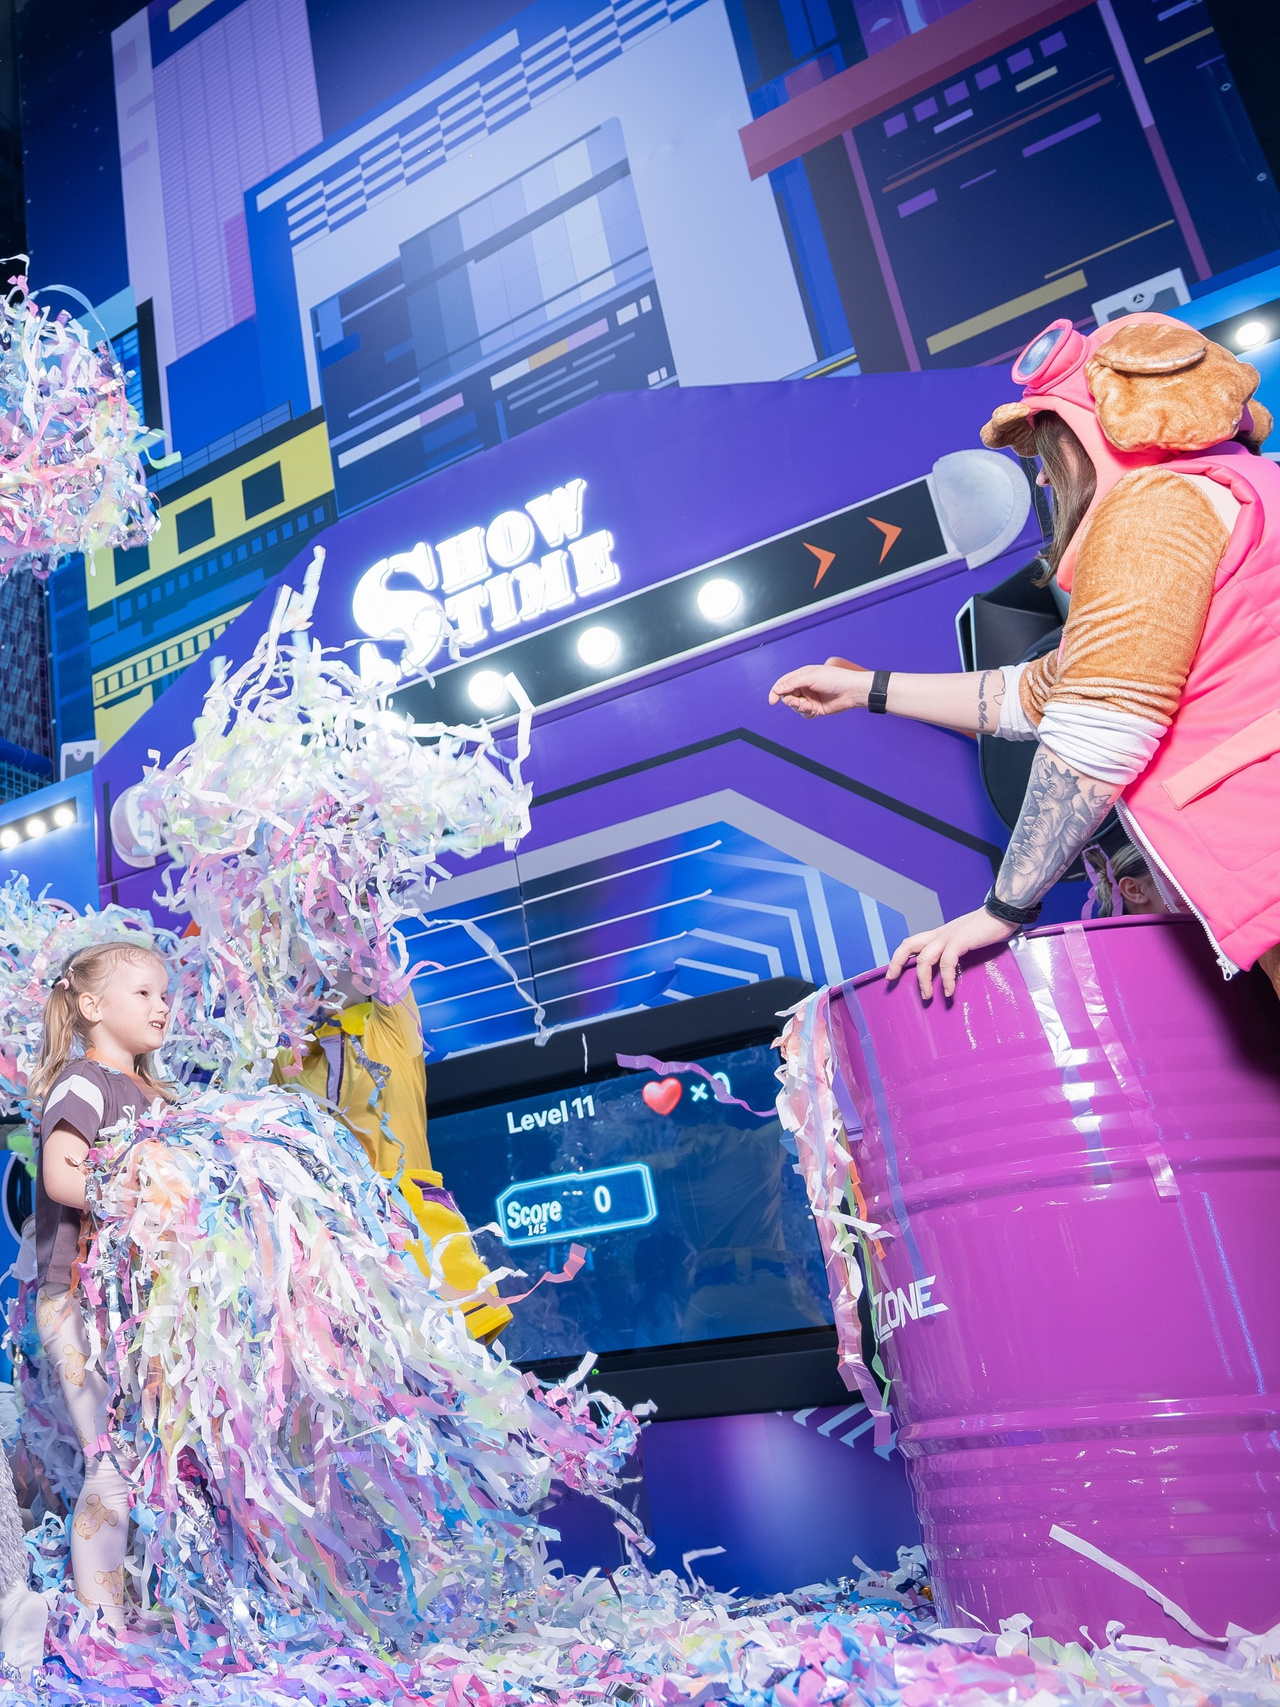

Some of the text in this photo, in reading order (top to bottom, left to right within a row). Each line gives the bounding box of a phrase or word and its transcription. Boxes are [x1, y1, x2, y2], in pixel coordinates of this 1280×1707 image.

[352, 478, 587, 686] SHOW
[444, 529, 620, 646] TIME
[506, 1095, 596, 1134] Level 11
[507, 1185, 611, 1229] Score 0
[528, 1222, 547, 1236] 145
[873, 1275, 949, 1344] ZONE
